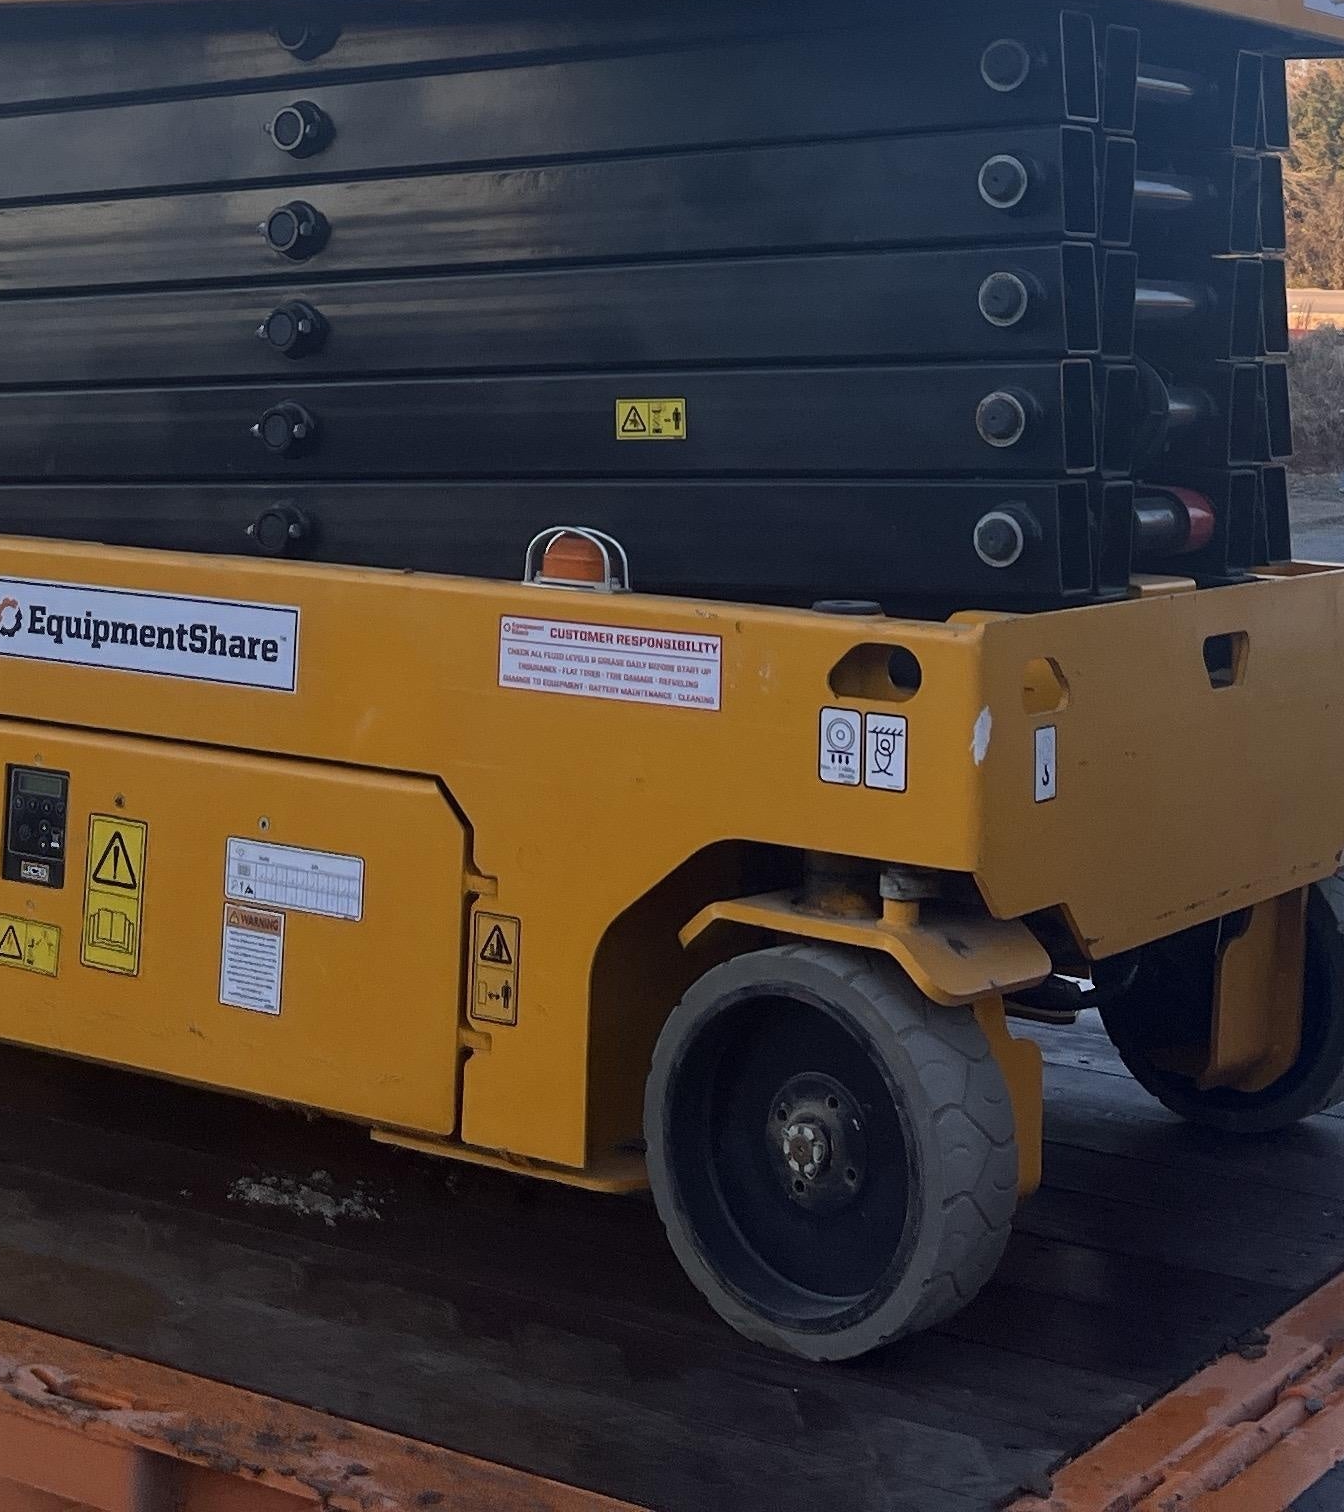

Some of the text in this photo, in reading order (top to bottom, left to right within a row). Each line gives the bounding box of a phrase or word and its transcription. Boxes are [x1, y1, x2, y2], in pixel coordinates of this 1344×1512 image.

[28, 605, 279, 663] EquipmentShare
[550, 627, 719, 654] CUSTOMER RESPONSIBILITY
[241, 913, 279, 932] WARNING
